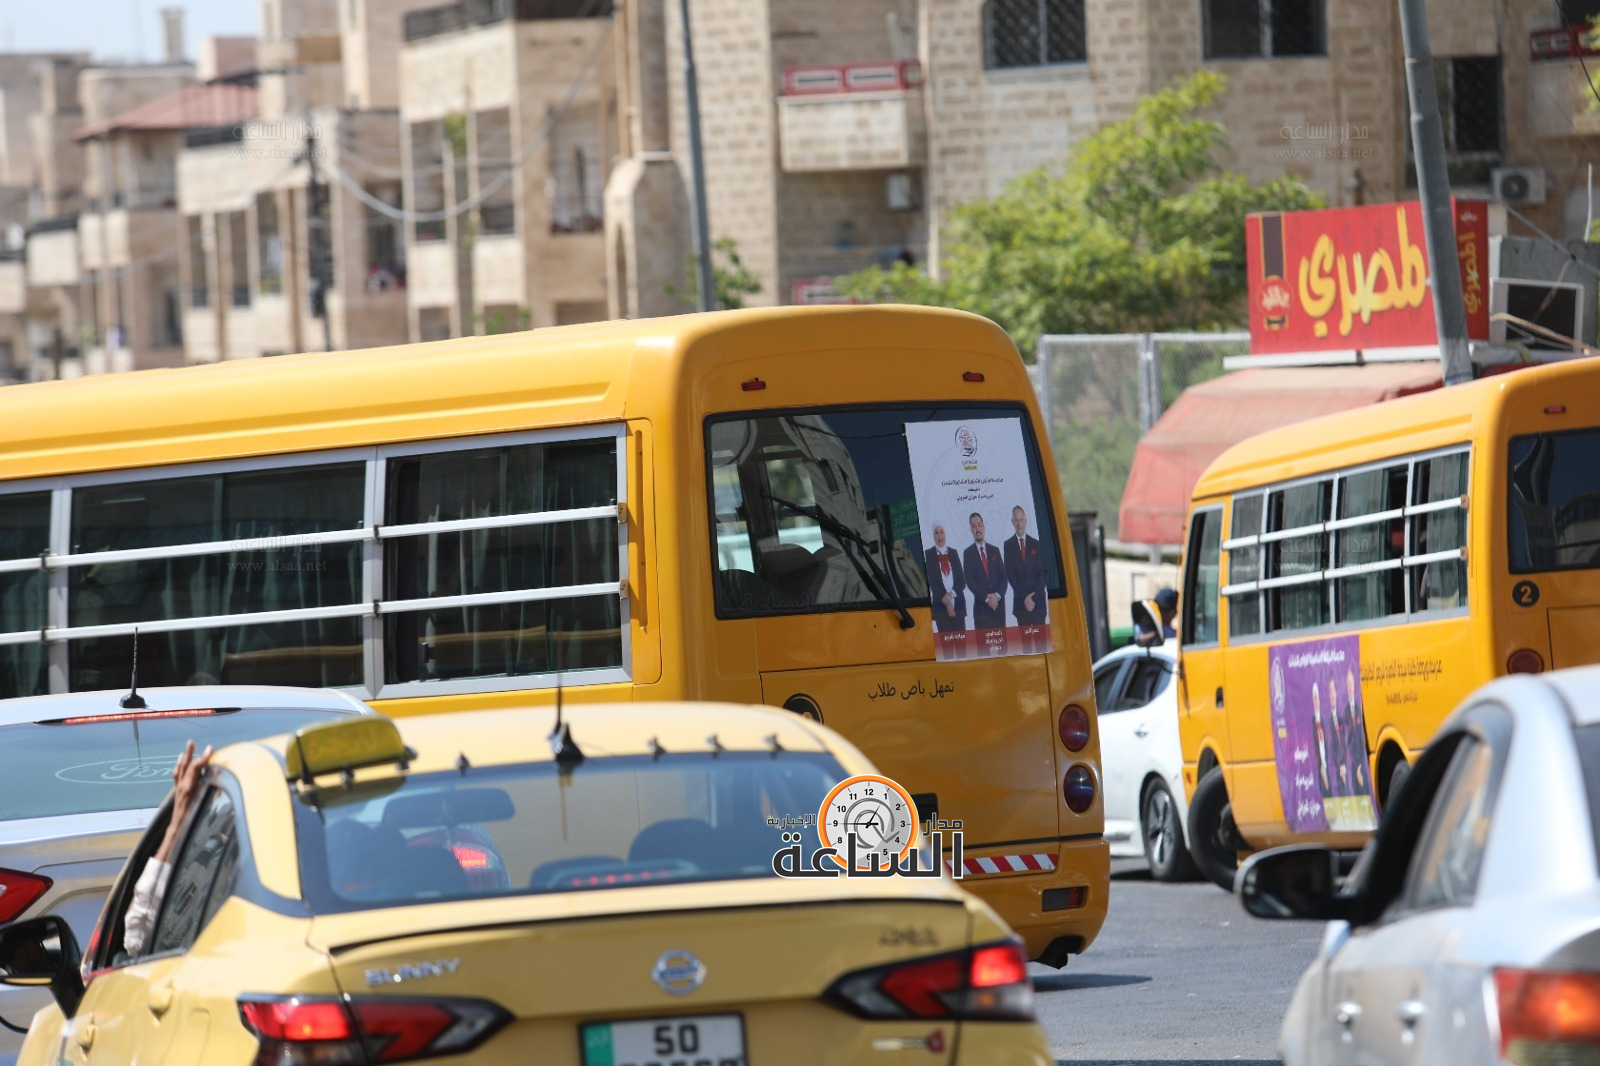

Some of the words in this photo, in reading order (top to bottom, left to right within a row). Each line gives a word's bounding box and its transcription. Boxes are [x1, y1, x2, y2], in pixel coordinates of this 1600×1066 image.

[1299, 205, 1426, 338] لمصري
[1520, 584, 1533, 603] 2
[868, 682, 896, 702] طلاب
[901, 680, 925, 700] باص
[101, 760, 177, 780] For
[363, 957, 463, 987] SUNNY
[653, 1023, 699, 1057] 50
